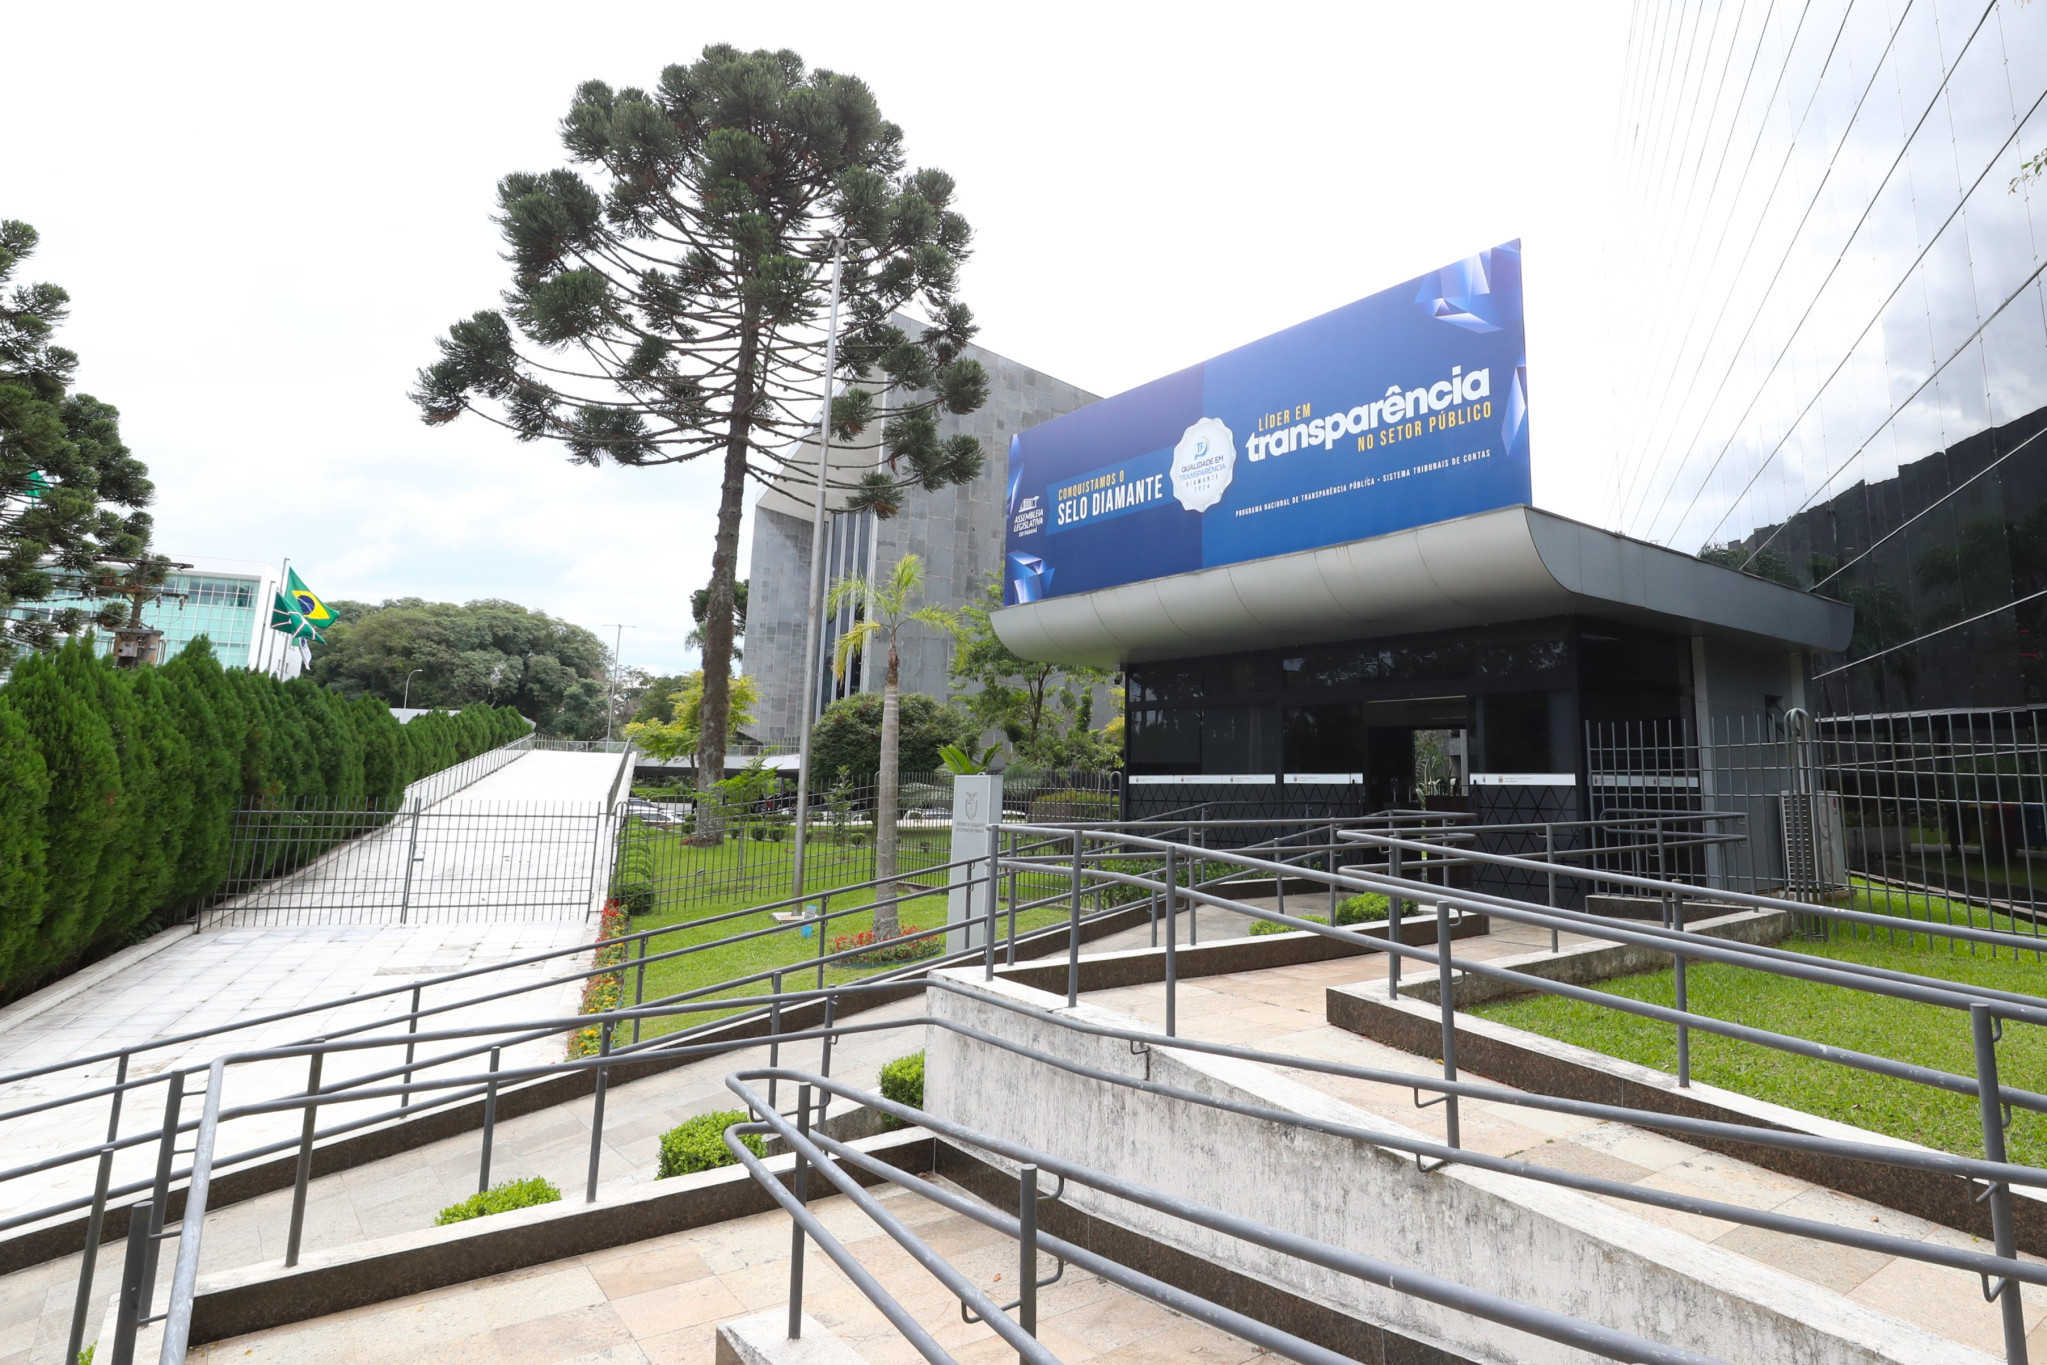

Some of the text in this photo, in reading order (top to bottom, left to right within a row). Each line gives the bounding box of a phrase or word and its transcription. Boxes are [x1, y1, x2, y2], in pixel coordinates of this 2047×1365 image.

[1245, 365, 1490, 462] transparência
[1259, 403, 1311, 432] LÍDER EM
[1358, 402, 1491, 452] NO SETOR PÚBLICO
[1179, 463, 1227, 481] TRANSPARÊNCIA
[1181, 455, 1224, 473] QUALIDADE EM
[1058, 470, 1125, 501] CONQUISTAMOS O
[1235, 505, 1263, 518] PROGRAMA
[1264, 498, 1290, 511] NACIONAL
[1292, 495, 1299, 504] DE
[1301, 484, 1347, 502] TRANSPARÊNCIA
[1383, 469, 1410, 482] SISTEMA
[1413, 459, 1449, 475] TRIBUNAIS
[1452, 456, 1460, 466] DE
[1463, 449, 1491, 463] CONTAS
[1058, 474, 1163, 525] SELO DIAMANTE
[1014, 517, 1044, 533] LEGISLATIVA
